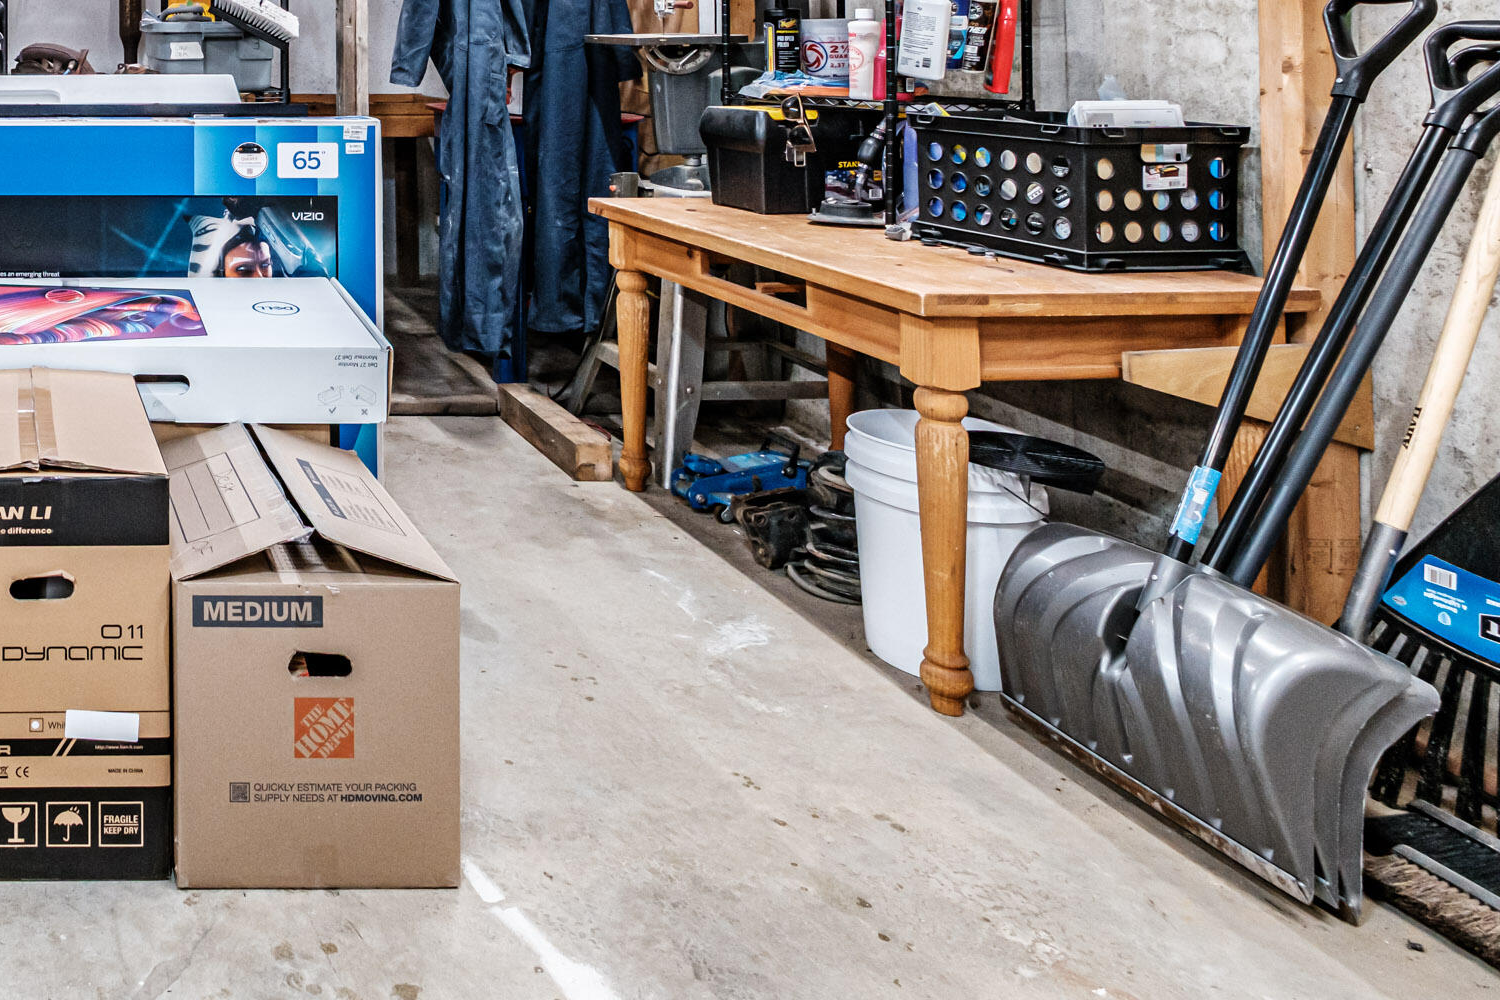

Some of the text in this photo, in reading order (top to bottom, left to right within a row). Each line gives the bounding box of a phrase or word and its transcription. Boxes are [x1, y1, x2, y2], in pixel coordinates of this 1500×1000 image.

[291, 212, 324, 221] VIZIO
[7, 270, 15, 278] an
[15, 270, 42, 278] emerging
[42, 270, 60, 278] threat
[30, 505, 52, 520] LI
[7, 527, 53, 535] difference
[203, 600, 313, 622] MEDIUM
[2, 645, 144, 662] DYNAMIC
[300, 703, 325, 728] THE
[294, 698, 354, 758] HOME
[318, 719, 354, 759] DEPOT
[253, 782, 417, 792] QUICKLY ESTIMATE YOUR PACKING
[253, 793, 423, 803] SUPPLY NEEDS AT HDMOVING.COM
[103, 814, 139, 824] FRAGILE
[103, 826, 139, 835] KEEP DRY
